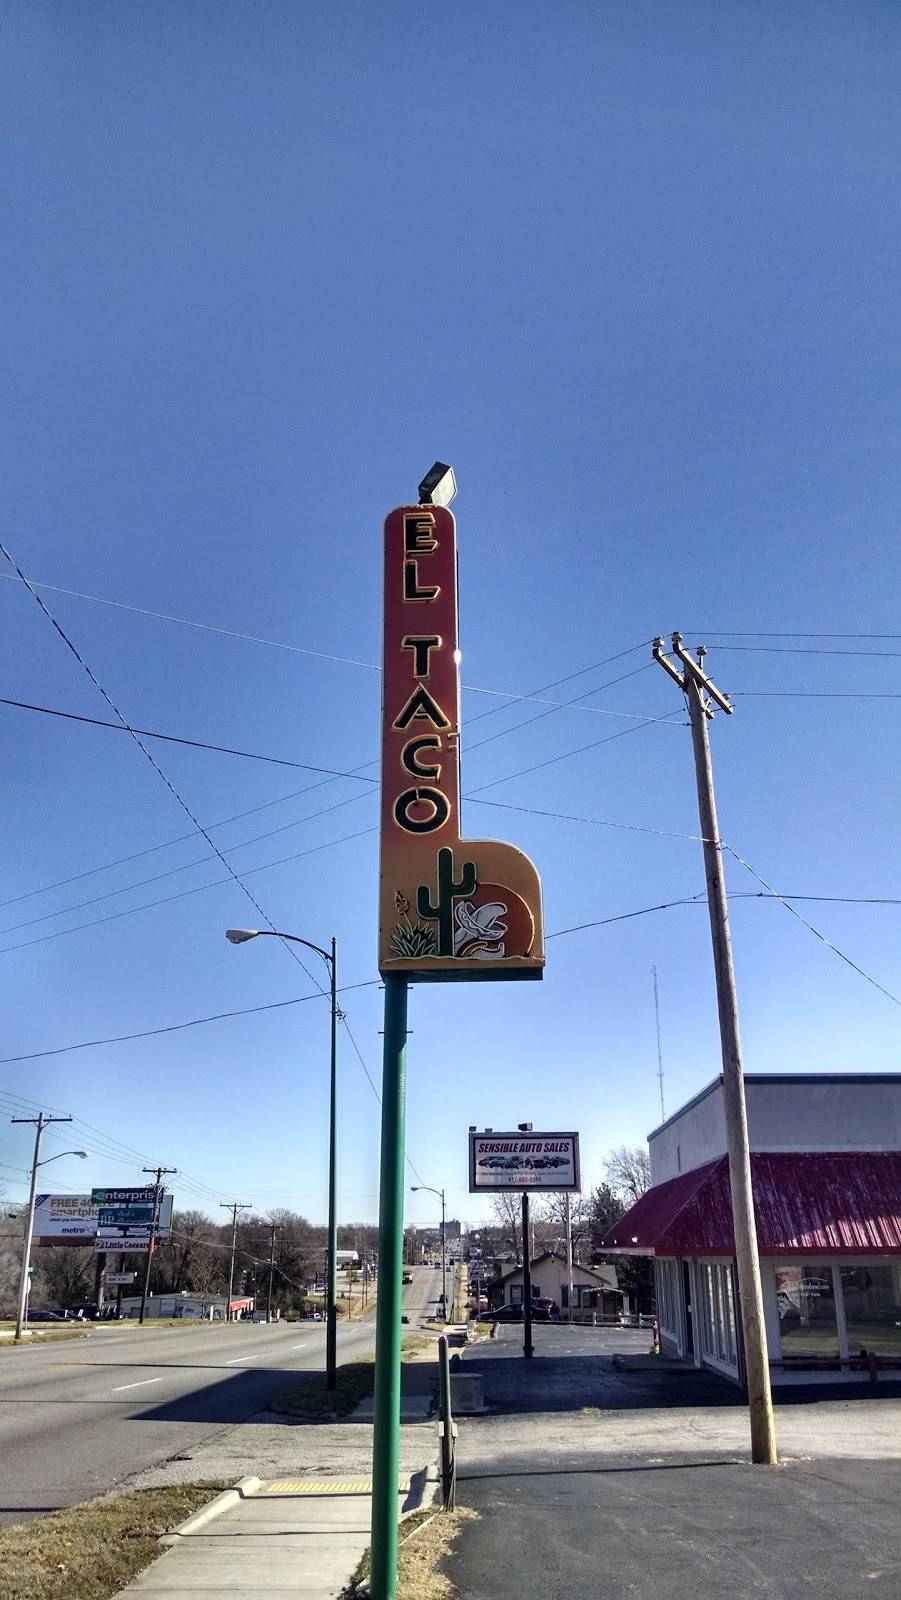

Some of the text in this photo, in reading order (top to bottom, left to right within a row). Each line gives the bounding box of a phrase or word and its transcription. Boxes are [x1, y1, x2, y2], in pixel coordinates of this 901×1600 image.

[392, 513, 452, 835] EL TACO
[478, 1142, 570, 1153] SENSIBLE AUTO SALES
[50, 1199, 79, 1208] FREE
[105, 1241, 123, 1249] Little
